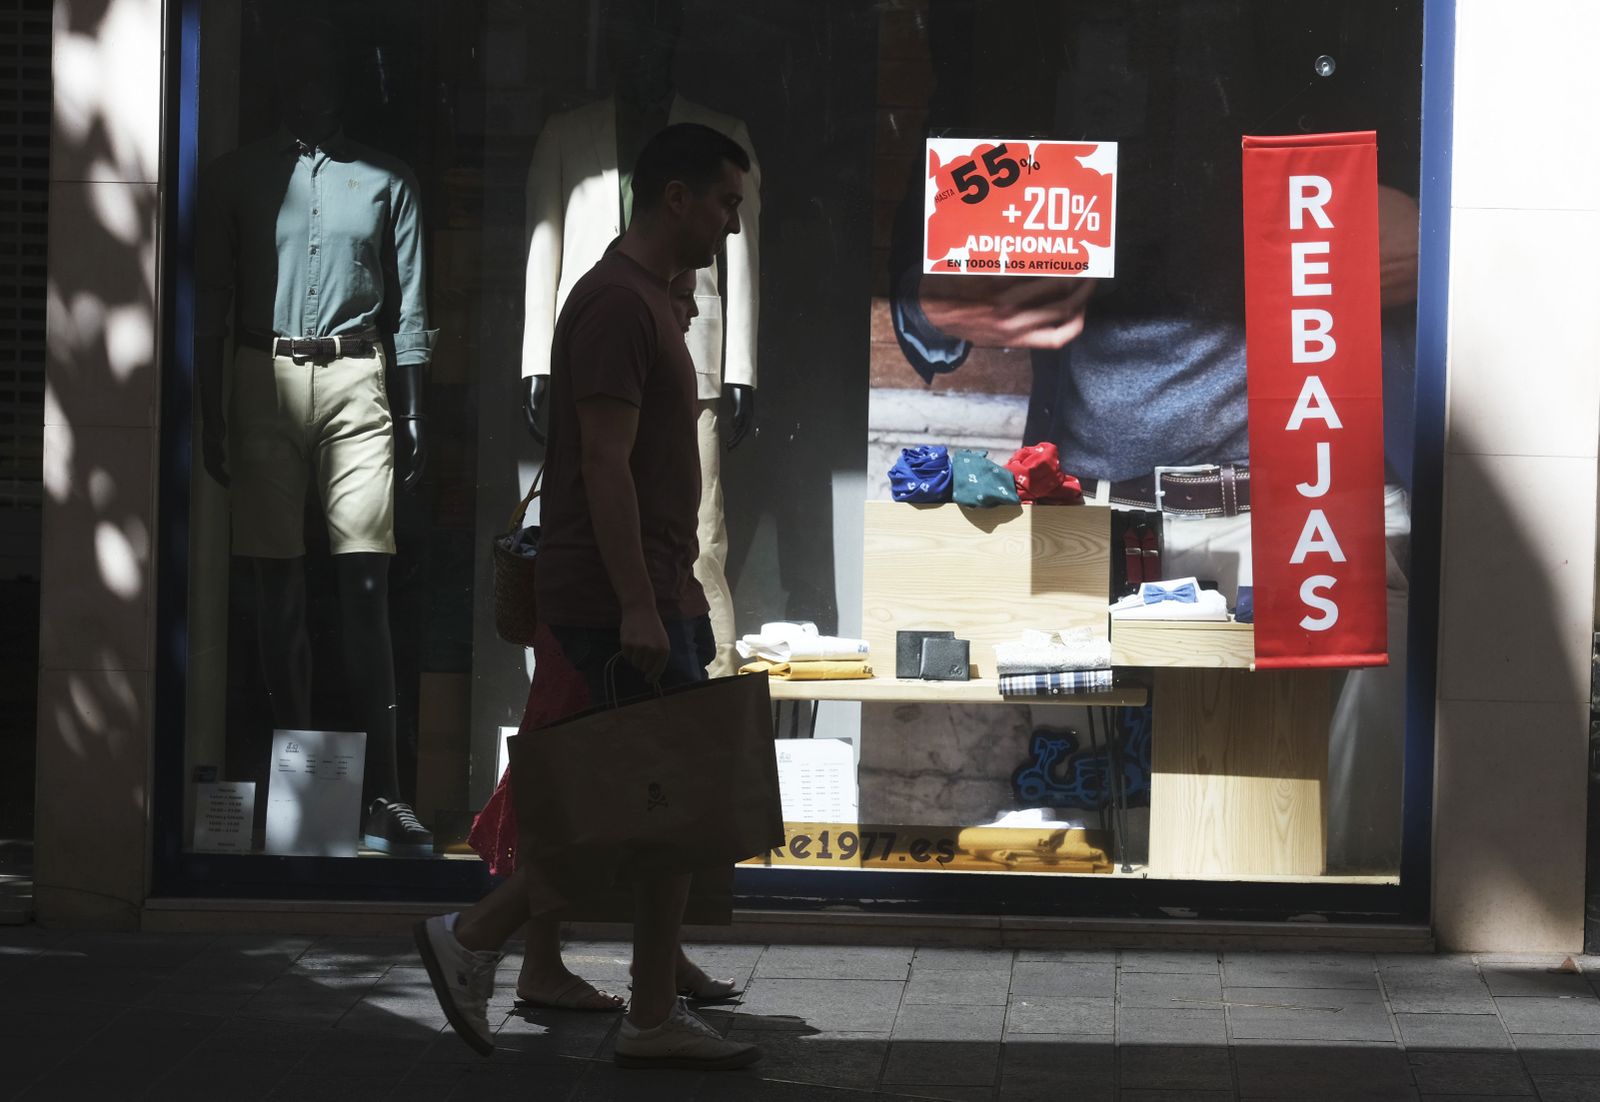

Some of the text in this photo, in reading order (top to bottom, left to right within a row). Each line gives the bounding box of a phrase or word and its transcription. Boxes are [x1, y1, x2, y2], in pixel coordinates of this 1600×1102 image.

[934, 143, 1041, 205] HASTA 55%
[1002, 186, 1100, 231] +20%
[965, 235, 1079, 254] ADICIONAL
[947, 259, 1089, 271] EN TODOS LOS ARTÍCULOS
[1285, 175, 1346, 633] REBAJAS
[771, 830, 955, 863] e1977.es
